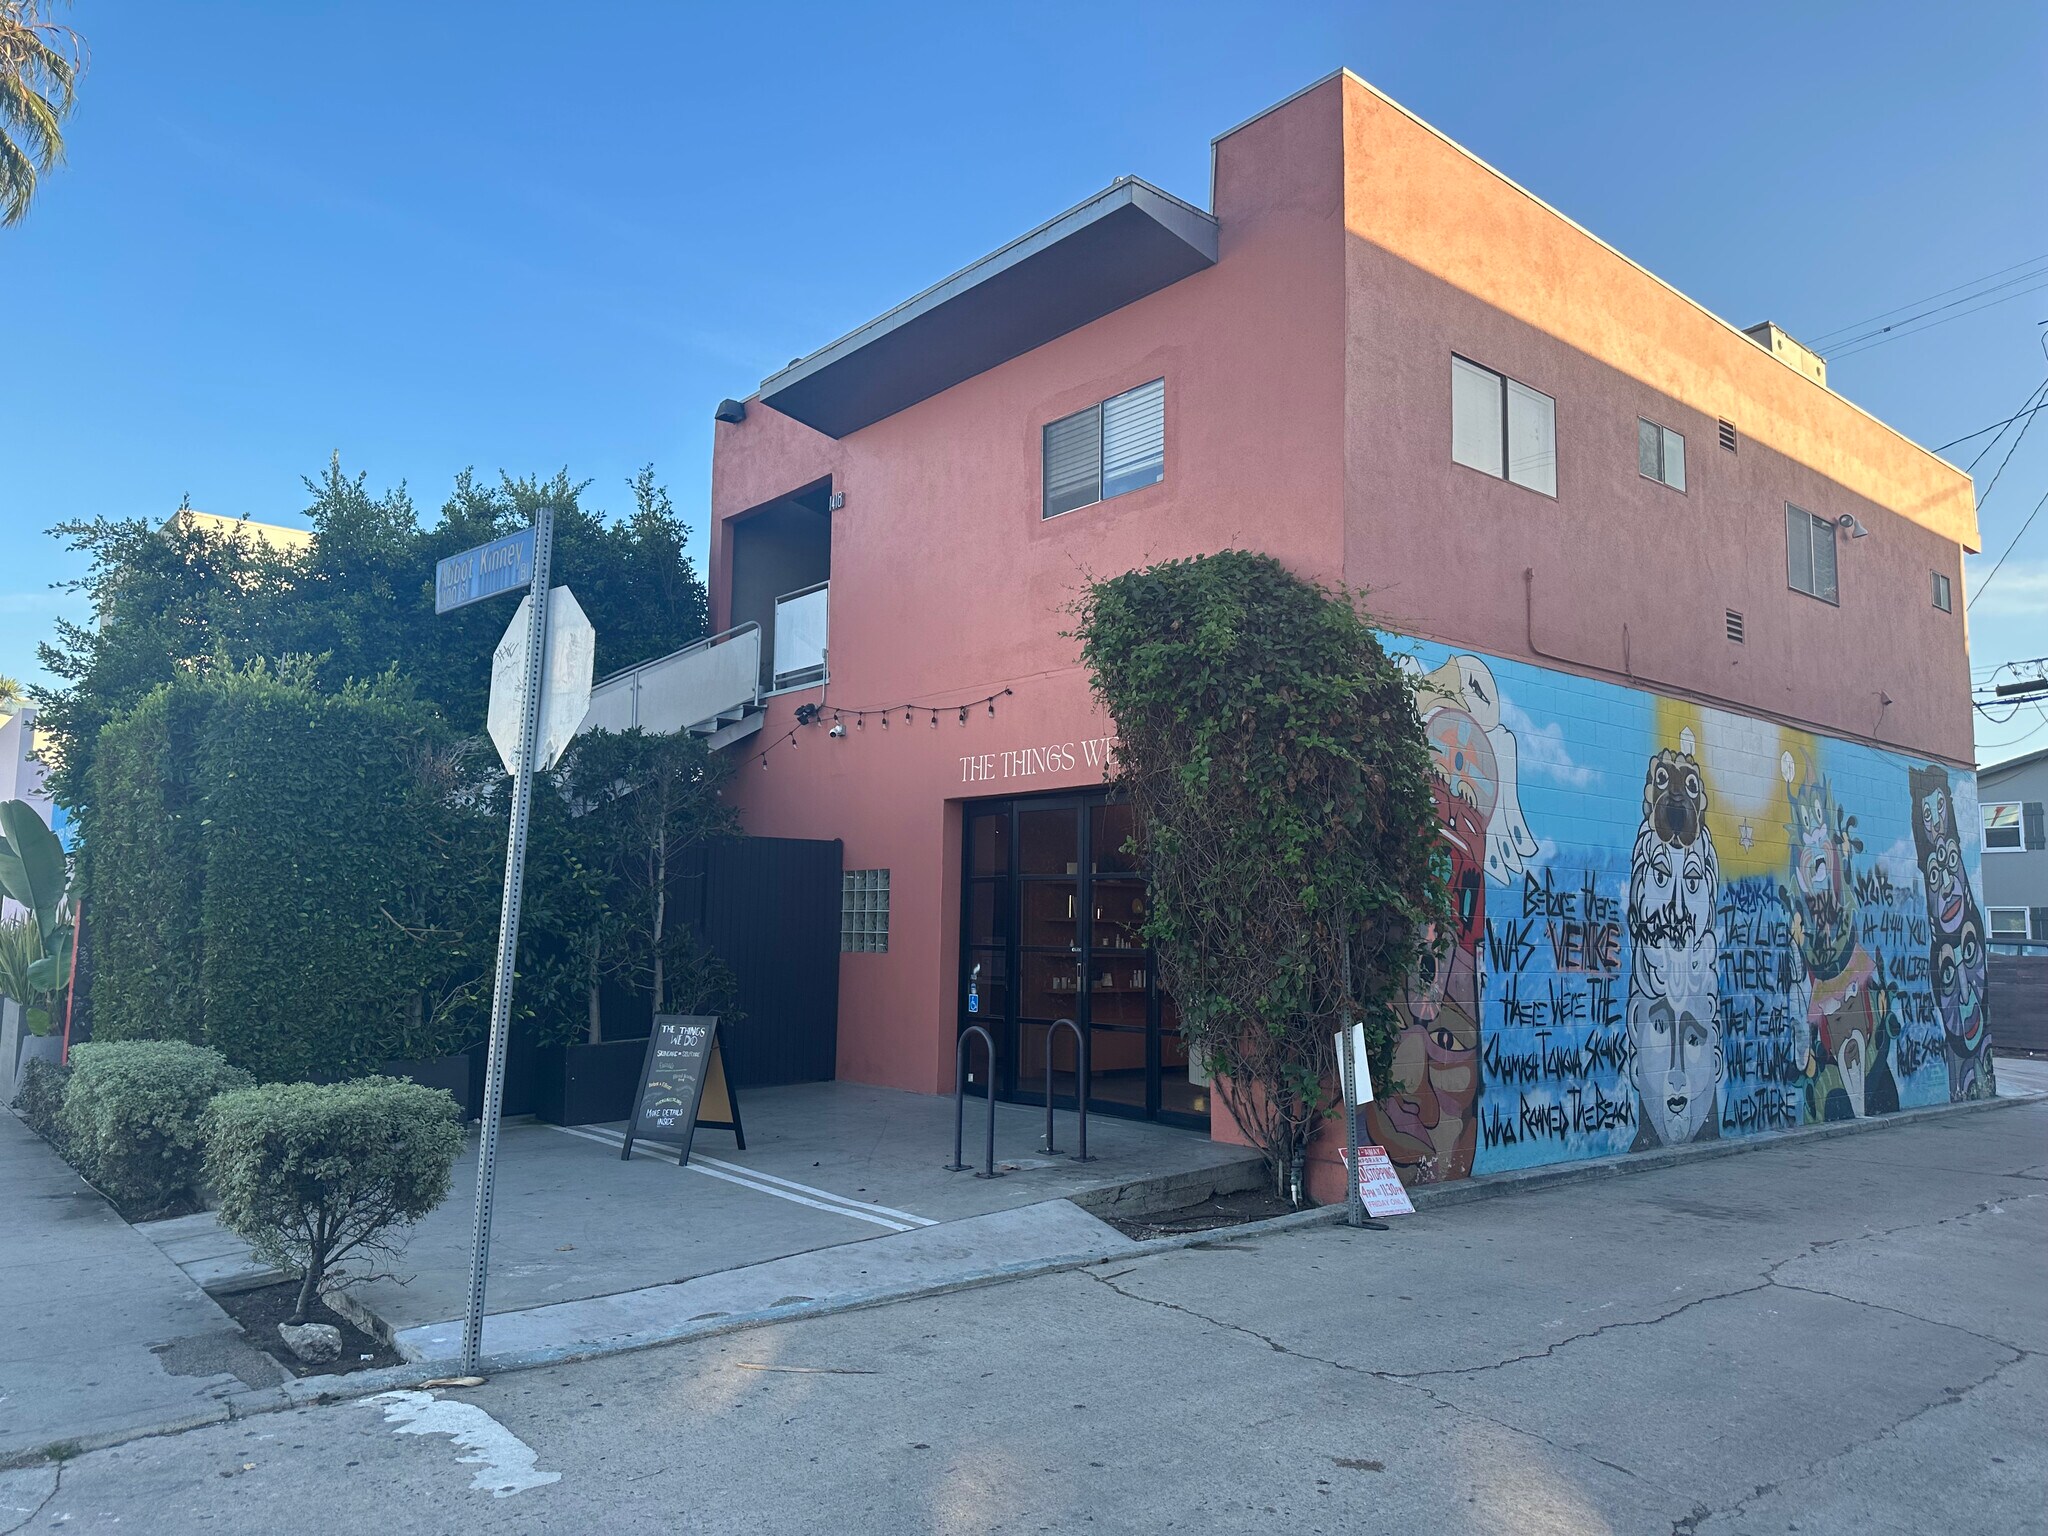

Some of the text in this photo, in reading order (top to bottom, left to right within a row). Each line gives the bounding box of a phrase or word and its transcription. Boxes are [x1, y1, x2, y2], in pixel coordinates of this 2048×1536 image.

[440, 542, 524, 587] Abbot Kinney
[959, 736, 1120, 782] THE THINGS WE
[1486, 917, 1536, 973] WAS
[1719, 951, 1776, 994] THERE
[662, 1025, 705, 1038] THE THINGS
[683, 1035, 698, 1047] DO
[1366, 1166, 1396, 1181] STOPPING
